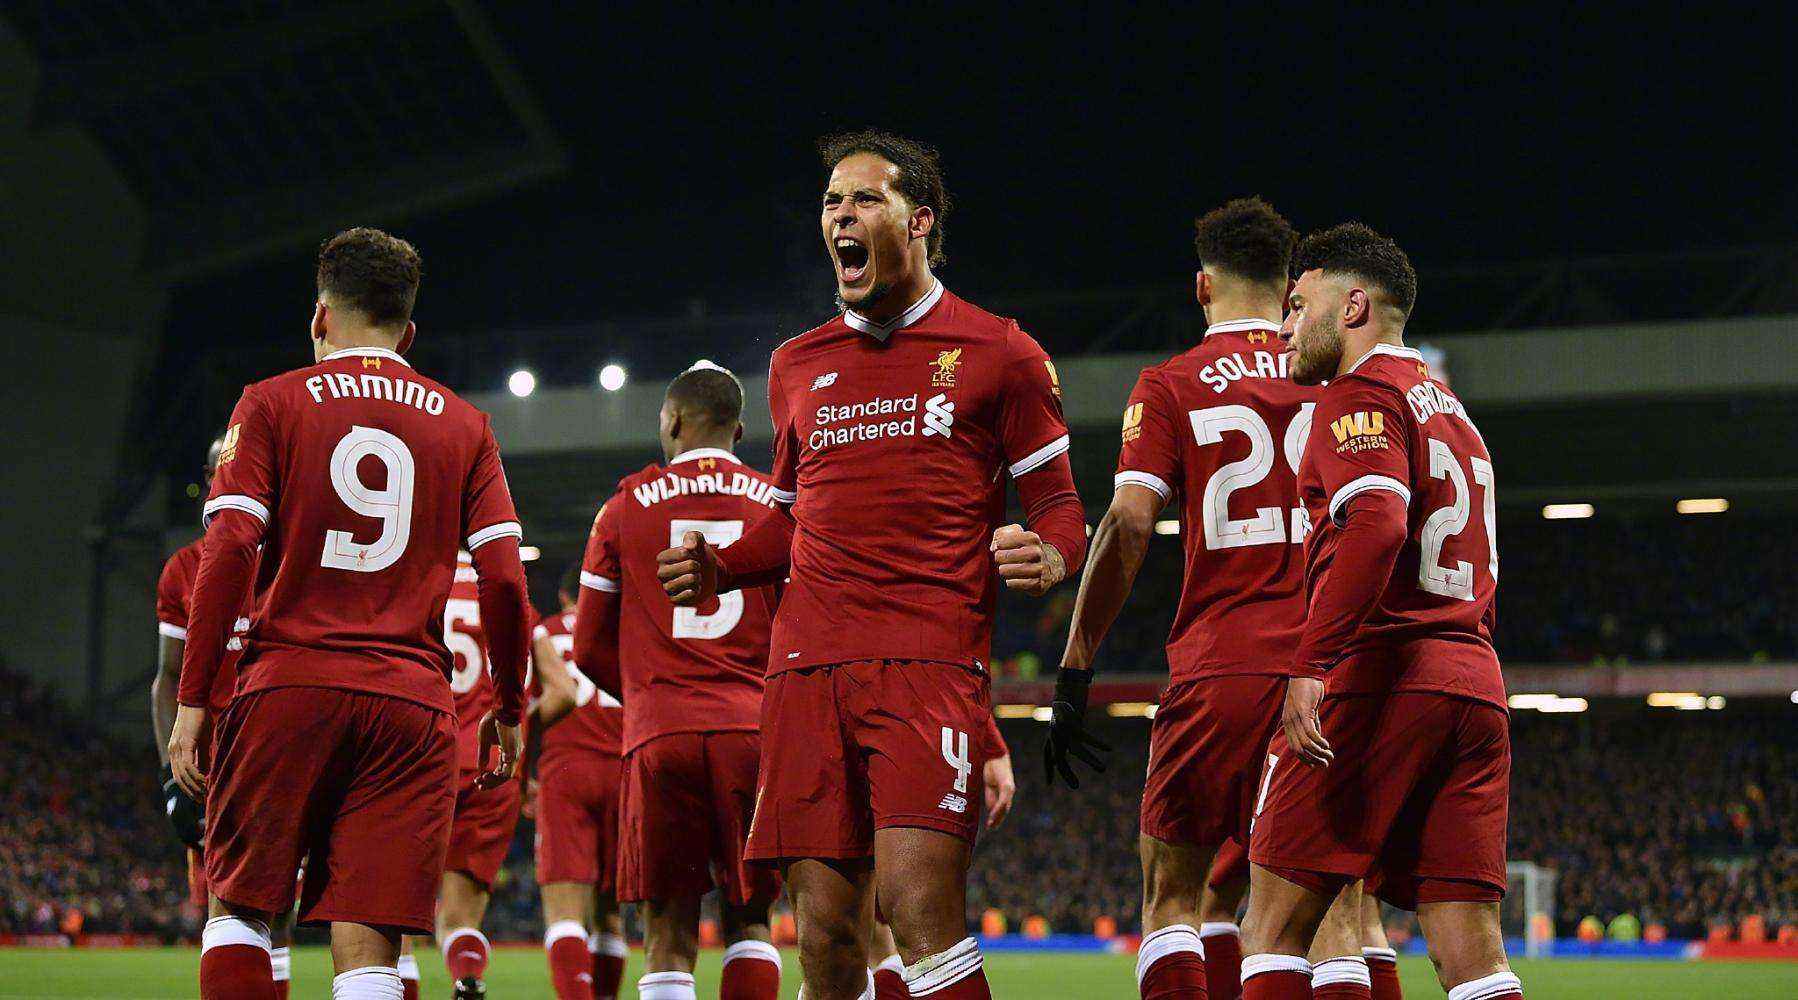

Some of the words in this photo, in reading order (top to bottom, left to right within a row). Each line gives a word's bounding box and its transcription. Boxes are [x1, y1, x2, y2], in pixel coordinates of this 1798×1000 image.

[305, 373, 446, 416] FIRMINO
[816, 393, 918, 425] Standard
[809, 416, 916, 451] Chartered
[1330, 411, 1384, 443] WU
[1336, 435, 1387, 453] WESTERN
[1351, 442, 1389, 453] UNION
[321, 425, 415, 573] 9
[633, 472, 776, 510] WIJNALDU
[941, 726, 972, 793] 4
